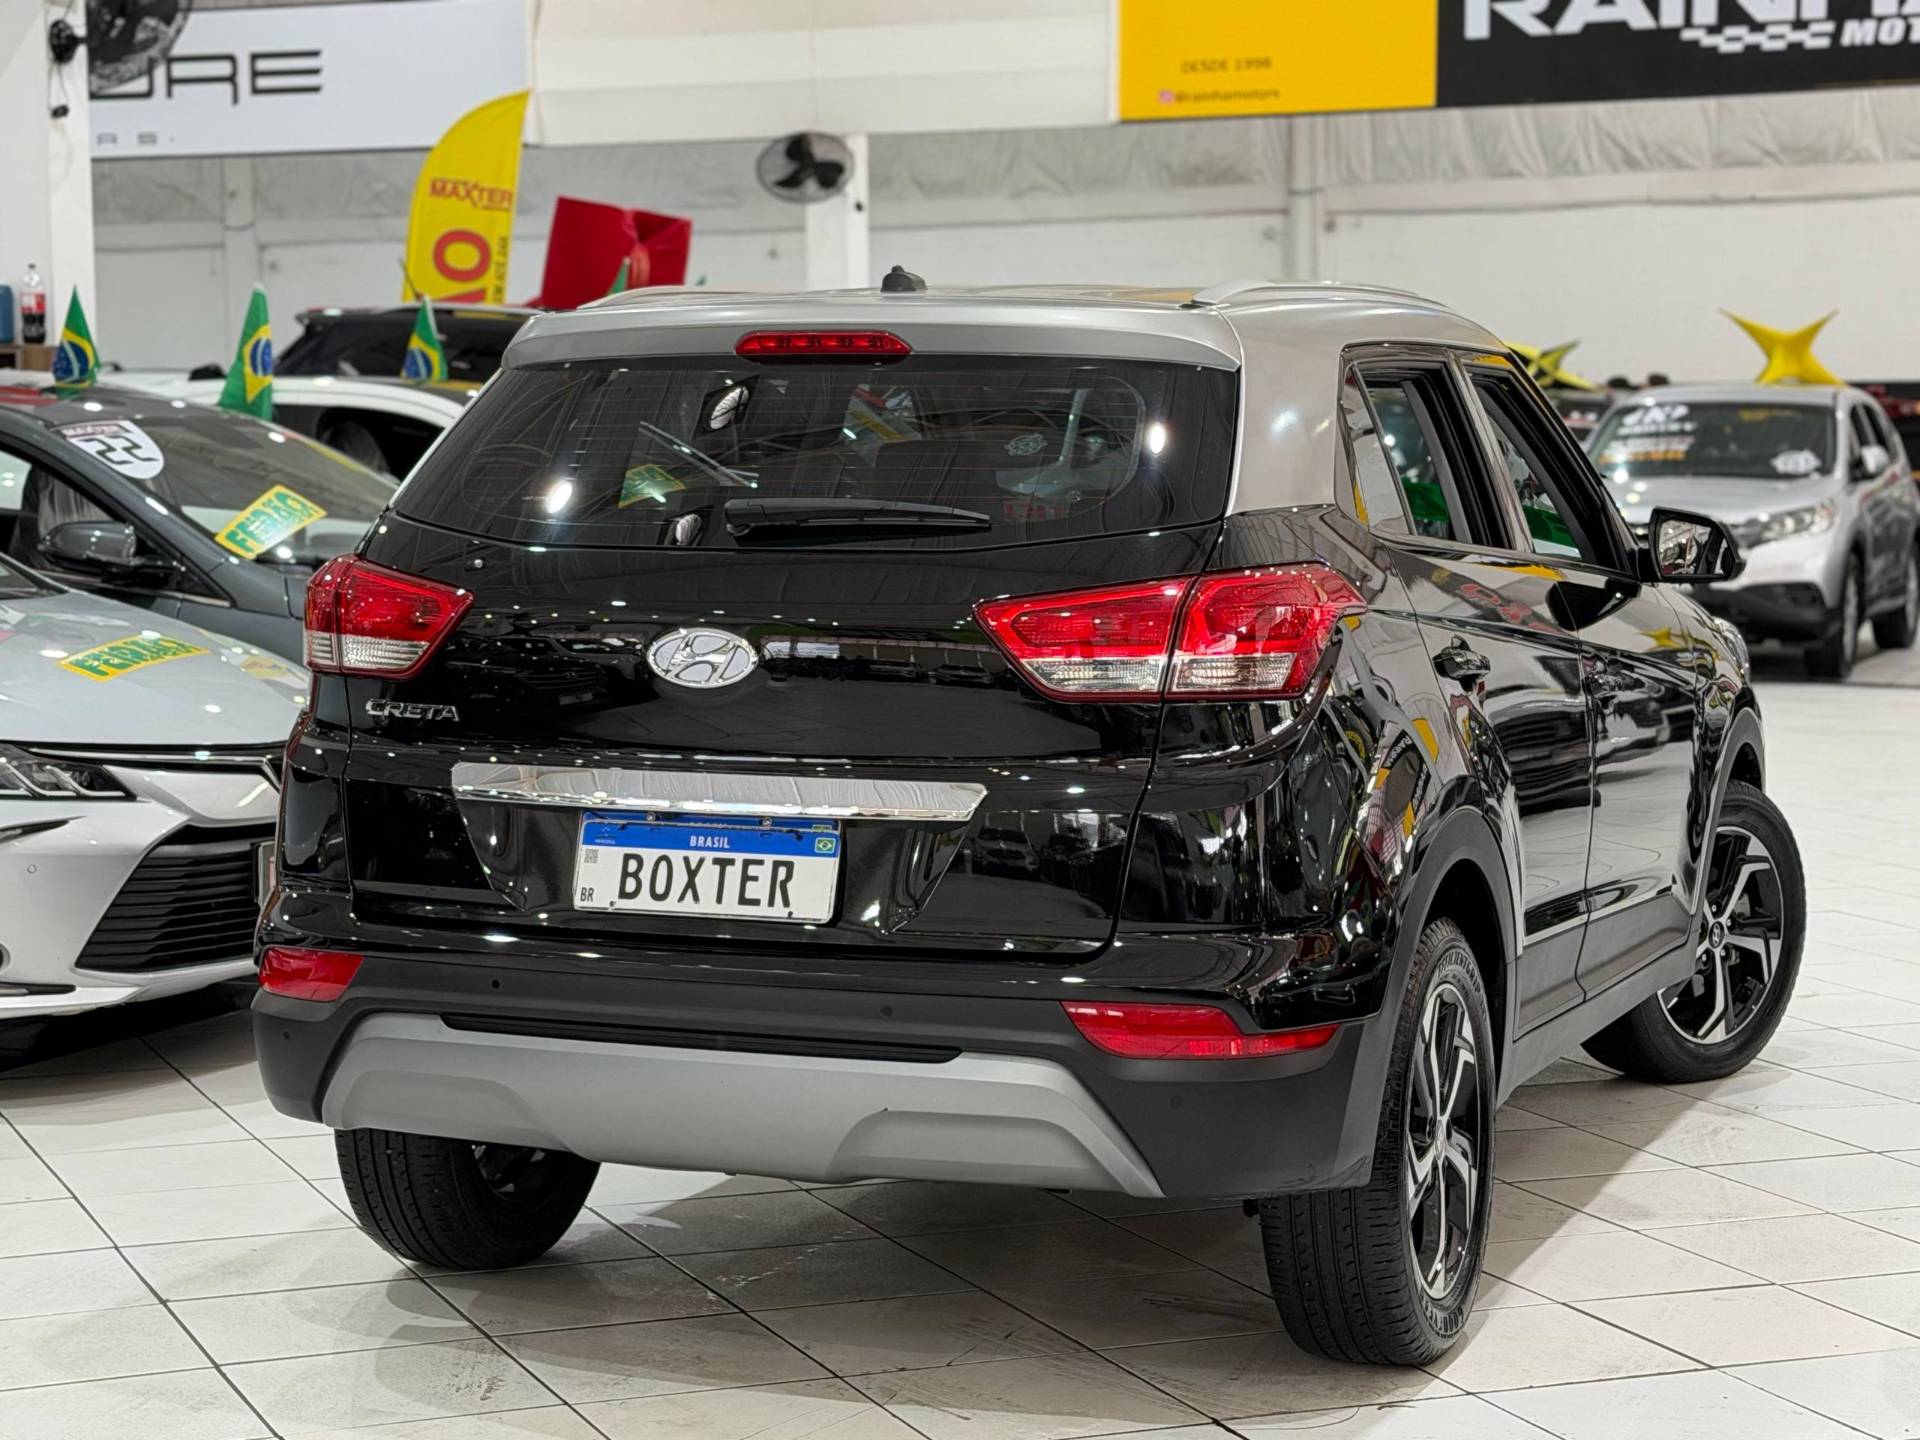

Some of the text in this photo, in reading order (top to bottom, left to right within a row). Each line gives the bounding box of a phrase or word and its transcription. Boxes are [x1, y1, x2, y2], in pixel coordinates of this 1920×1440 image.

[430, 178, 513, 208] MAXTER
[365, 698, 460, 721] CRETA
[690, 835, 730, 849] BRASIL
[618, 853, 795, 908] BOXTER
[580, 887, 594, 902] BR
